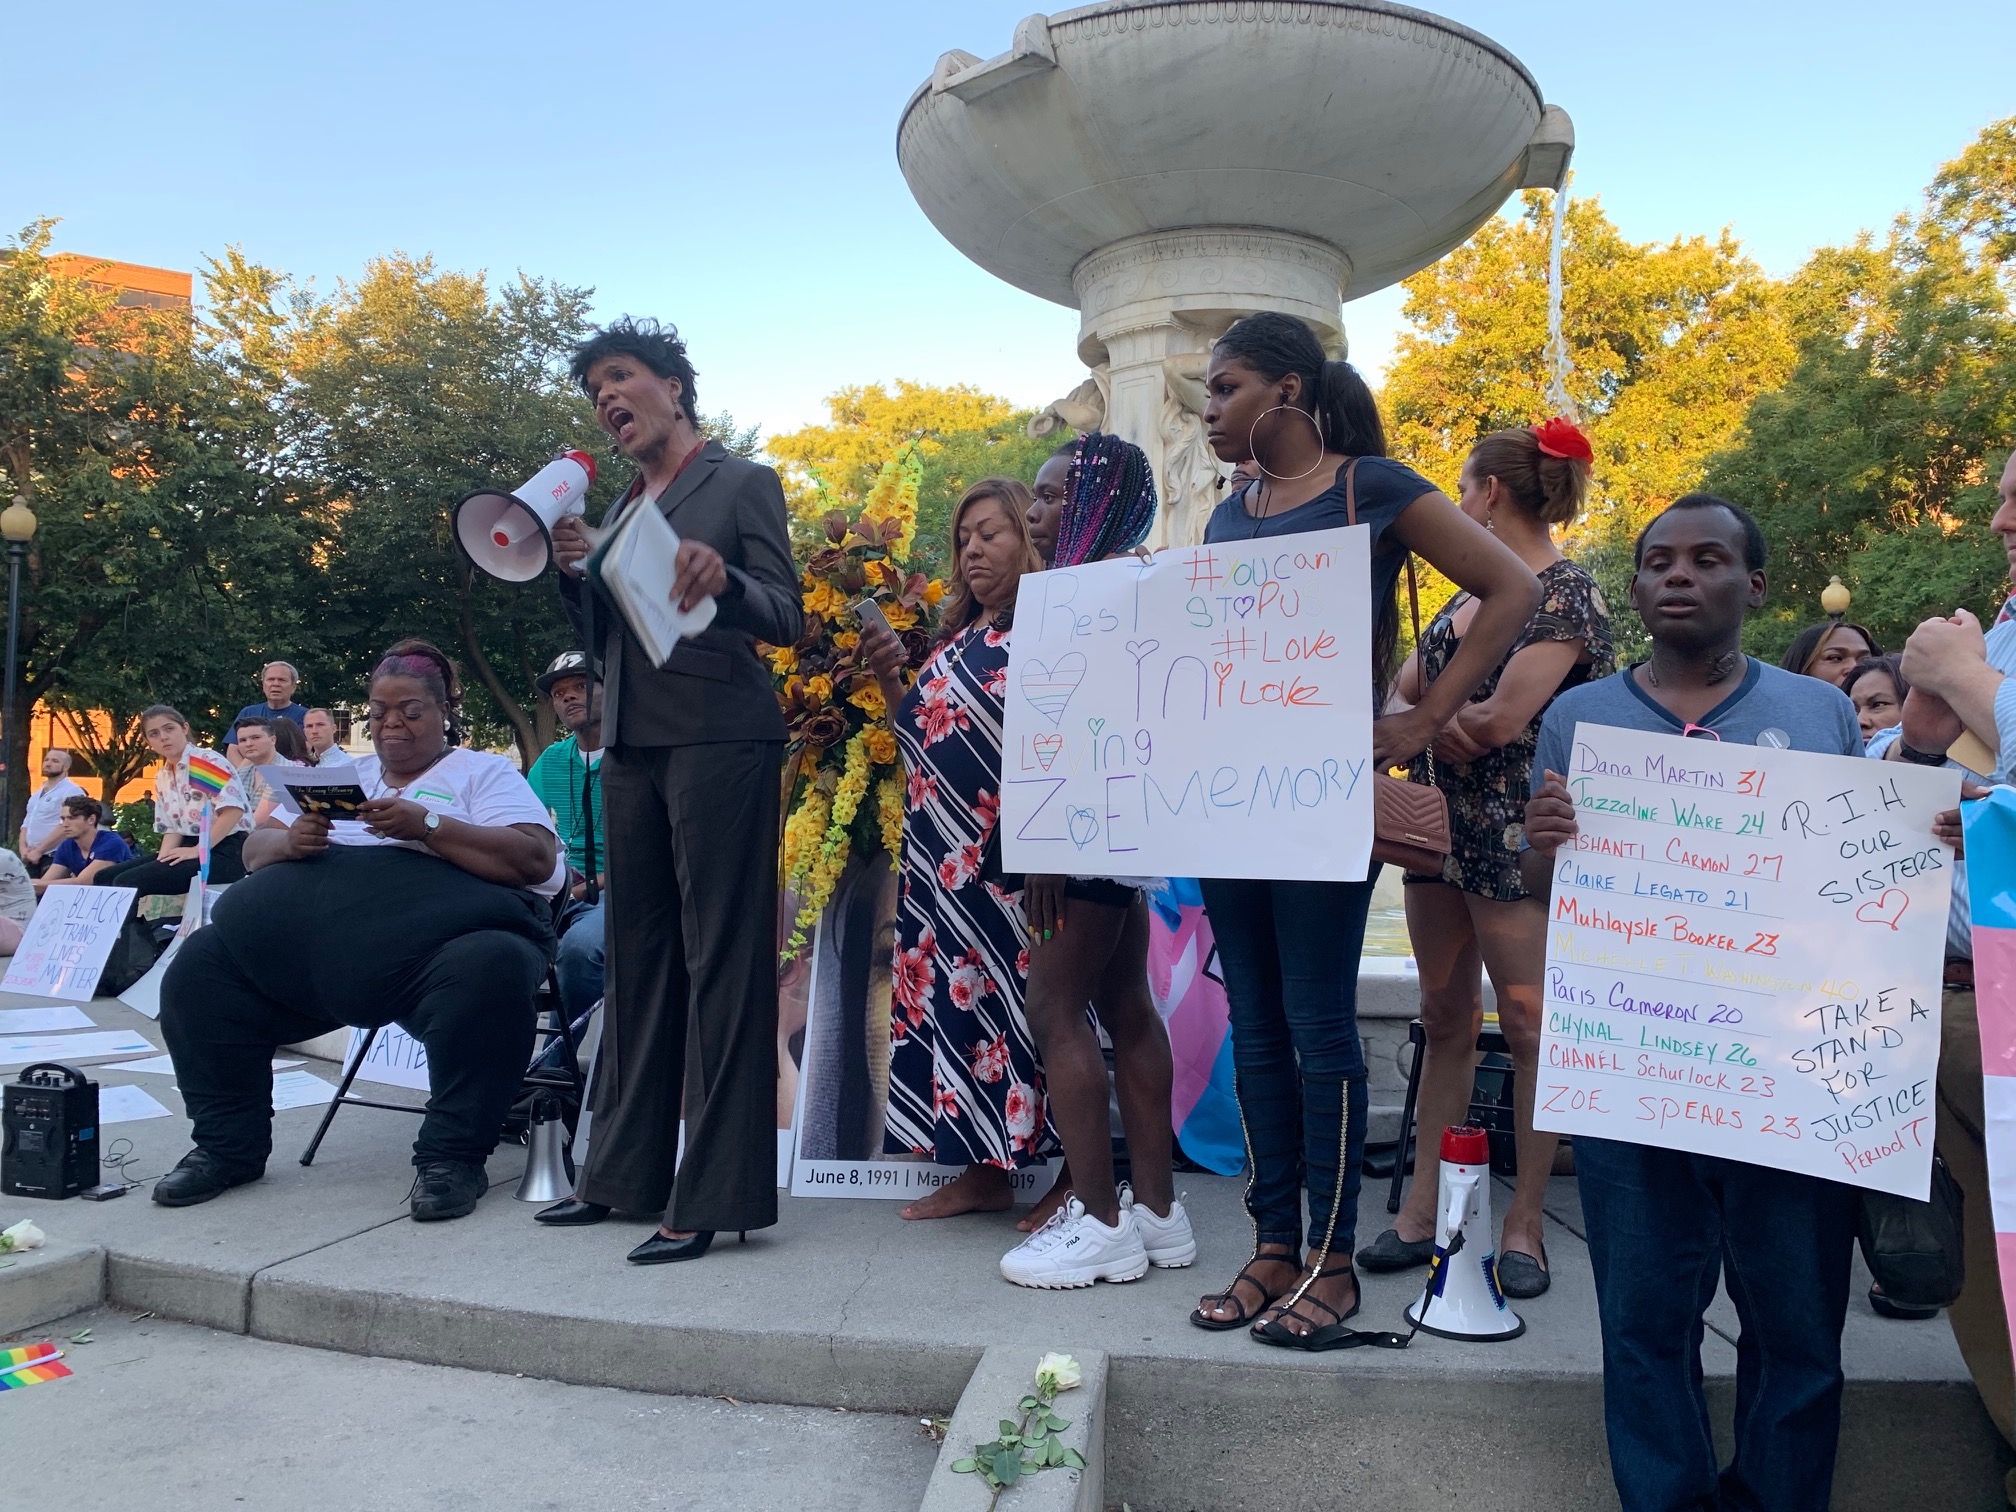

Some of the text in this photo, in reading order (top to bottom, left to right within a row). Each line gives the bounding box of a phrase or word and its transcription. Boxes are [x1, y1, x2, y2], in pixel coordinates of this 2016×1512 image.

[551, 480, 571, 501] PYLE
[1126, 640, 1207, 721] in
[1577, 743, 1766, 797] Dana MARTIN 31
[1671, 798, 1723, 830] WARE
[1736, 810, 1765, 835] 24
[1666, 837, 1730, 872] CARMON
[1743, 853, 1783, 881] 27
[1840, 830, 1902, 859] OUR
[1634, 872, 1708, 903] LEGATO
[1724, 890, 1748, 910] 21
[1818, 848, 1943, 903] SISTERS
[67, 888, 130, 923] BLACK
[61, 923, 98, 945] TRANS
[1665, 915, 1738, 951] BOOKER
[1745, 933, 1779, 956] 23
[49, 944, 85, 964] LIVES
[40, 963, 98, 989] MATTER
[1819, 979, 1859, 1001] 40
[1708, 1004, 1743, 1024] 20
[1804, 987, 1930, 1035] TAKE A
[1549, 1012, 1757, 1067] CHYNAL LINDSEY 26
[1791, 1025, 1903, 1073] STAND
[1740, 1076, 1775, 1097] 23
[1821, 1062, 1887, 1105] FOR
[1541, 1085, 1801, 1140] ZOE SPEARS 23
[1811, 1079, 1928, 1141] JUSTICE
[806, 1169, 845, 1185] June
[849, 1169, 863, 1186] 8,
[868, 1170, 898, 1186] 1991
[1010, 1173, 1035, 1189] 019
[1065, 1235, 1081, 1249] FILA
